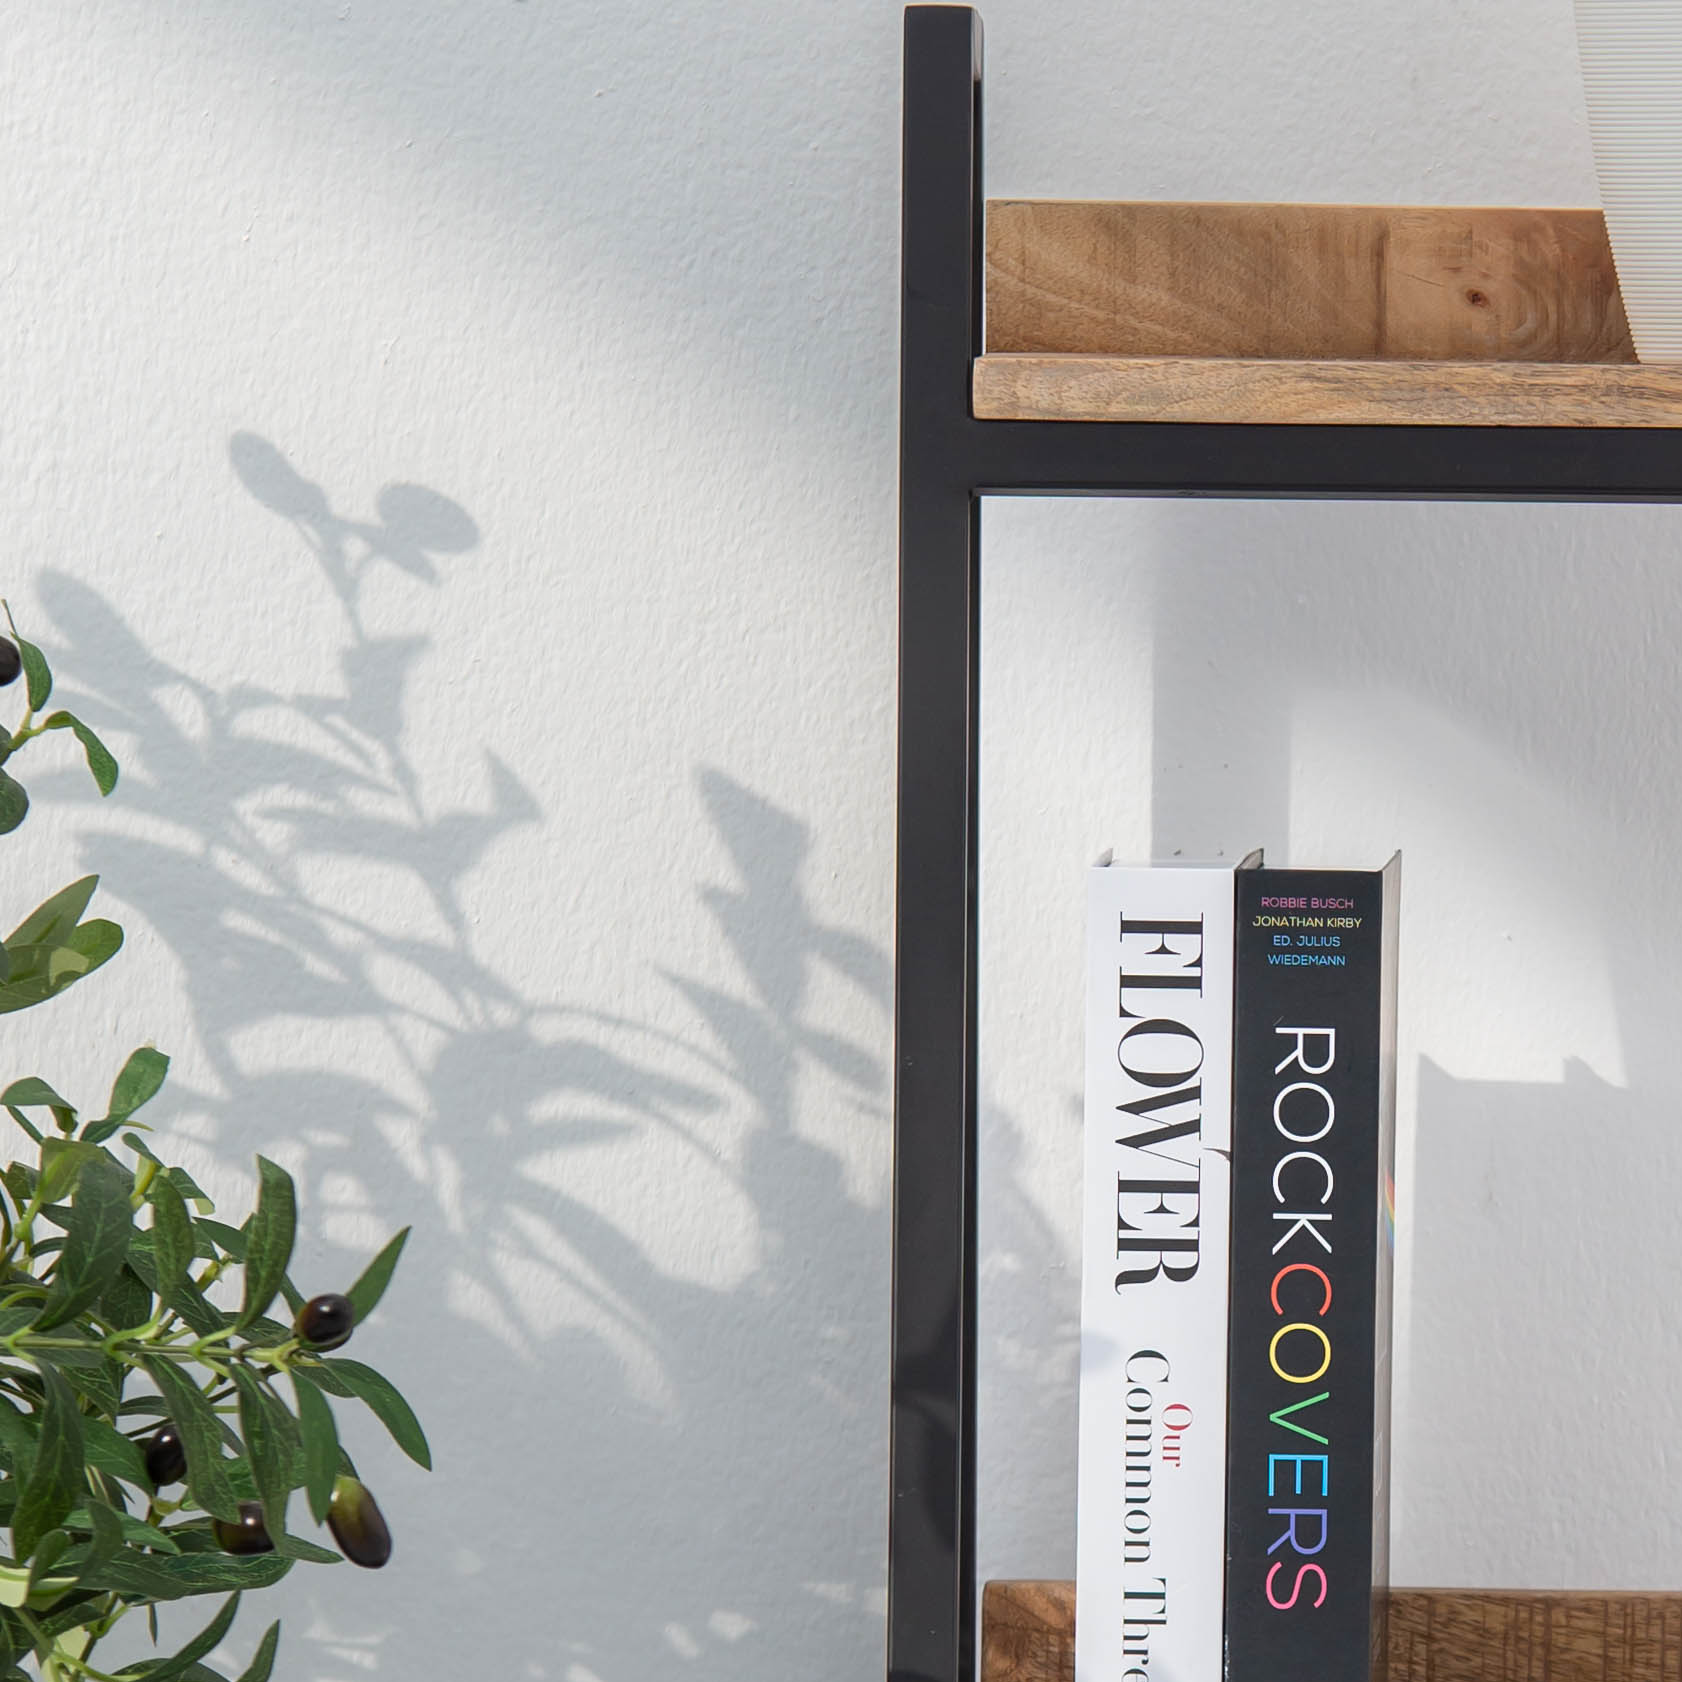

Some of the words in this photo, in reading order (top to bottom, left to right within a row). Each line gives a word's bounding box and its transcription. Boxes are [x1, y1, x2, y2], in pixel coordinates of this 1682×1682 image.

[1261, 896, 1307, 909] ROBBIE
[1311, 897, 1354, 909] BUSCH
[1252, 915, 1324, 928] JONATHAN
[1326, 917, 1363, 929] KIRBY
[1272, 934, 1293, 947] ED.
[1296, 935, 1341, 947] JULIUS
[1267, 954, 1346, 966] WIEDEMANN
[1114, 911, 1205, 1296] FLOWER
[1161, 1403, 1193, 1468] Our
[1123, 1349, 1169, 1566] Common
